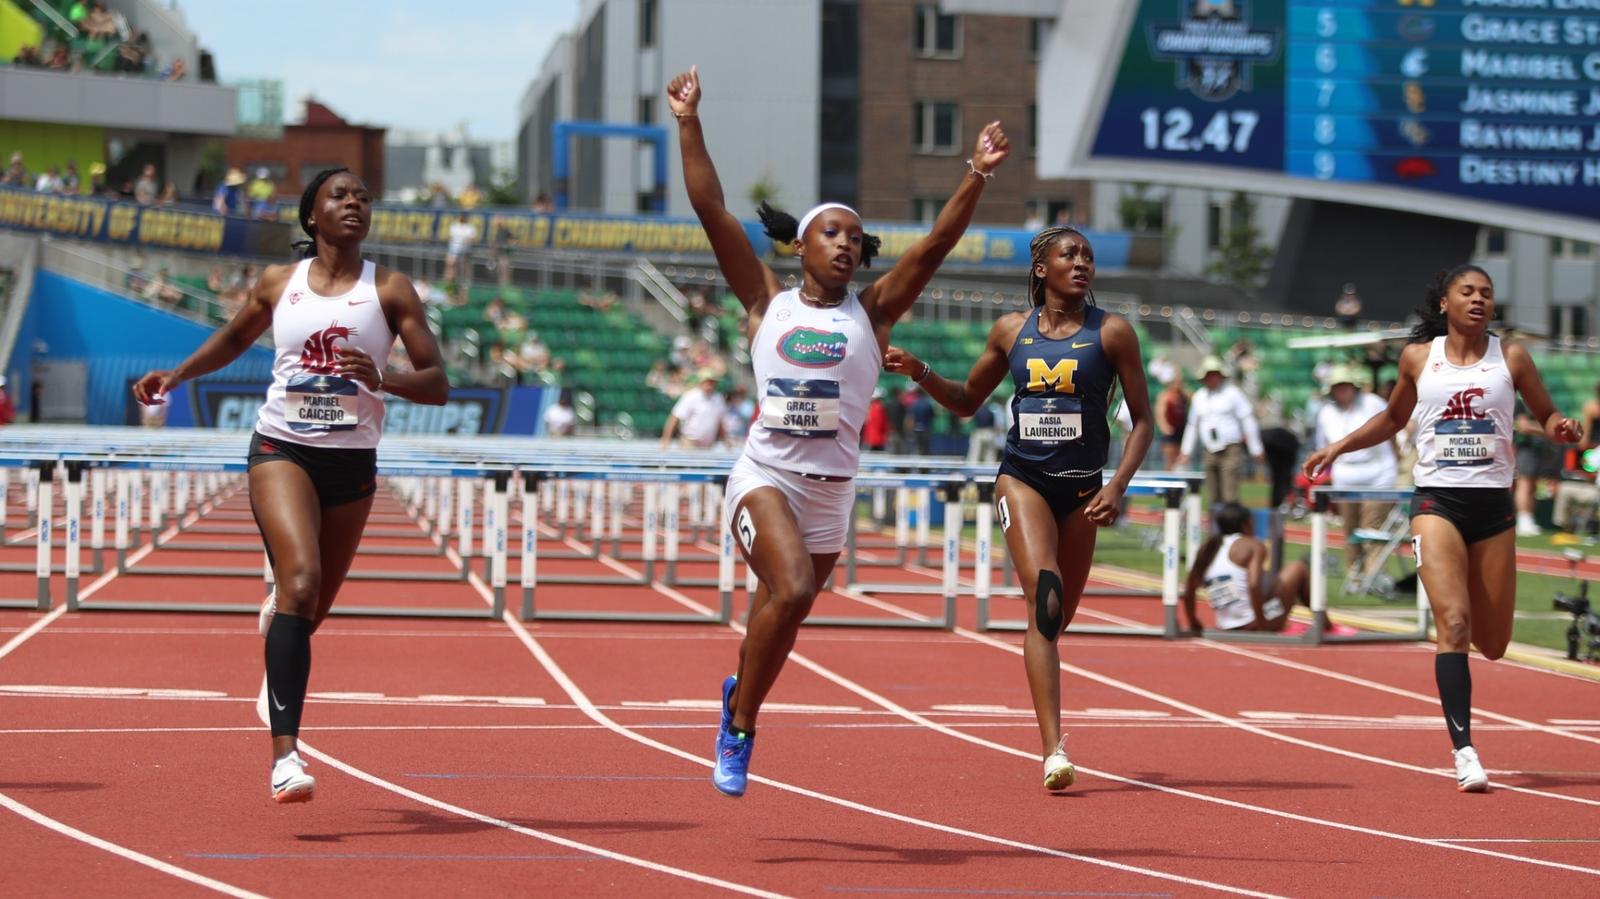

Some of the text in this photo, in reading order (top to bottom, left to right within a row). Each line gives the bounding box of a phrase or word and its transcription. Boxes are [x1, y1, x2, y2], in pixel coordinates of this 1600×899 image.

[1316, 8, 1337, 37] 5
[1461, 12, 1558, 44] GRACE
[1315, 44, 1336, 73] 6
[1461, 50, 1579, 80] MARIBEL
[1316, 79, 1335, 108] 7
[1460, 84, 1578, 115] JASMINE
[1140, 108, 1259, 152] 12.47
[1314, 114, 1335, 144] 8
[1460, 119, 1582, 150] RAYNIAH
[1313, 151, 1335, 180] 9
[1460, 154, 1579, 185] DESTINY
[109, 205, 137, 240] OF
[140, 209, 225, 251] OREGON
[1026, 358, 1078, 393] M
[299, 407, 345, 421] CAICEDO
[303, 395, 341, 407] MARIBEL
[786, 401, 817, 412] GRACE
[783, 414, 819, 427] STARK
[1025, 427, 1077, 438] LAURENCIN
[1039, 416, 1062, 425] AASIA
[1443, 447, 1487, 458] DE MELLO
[1449, 437, 1482, 446] MICAELA
[739, 514, 752, 548] 5
